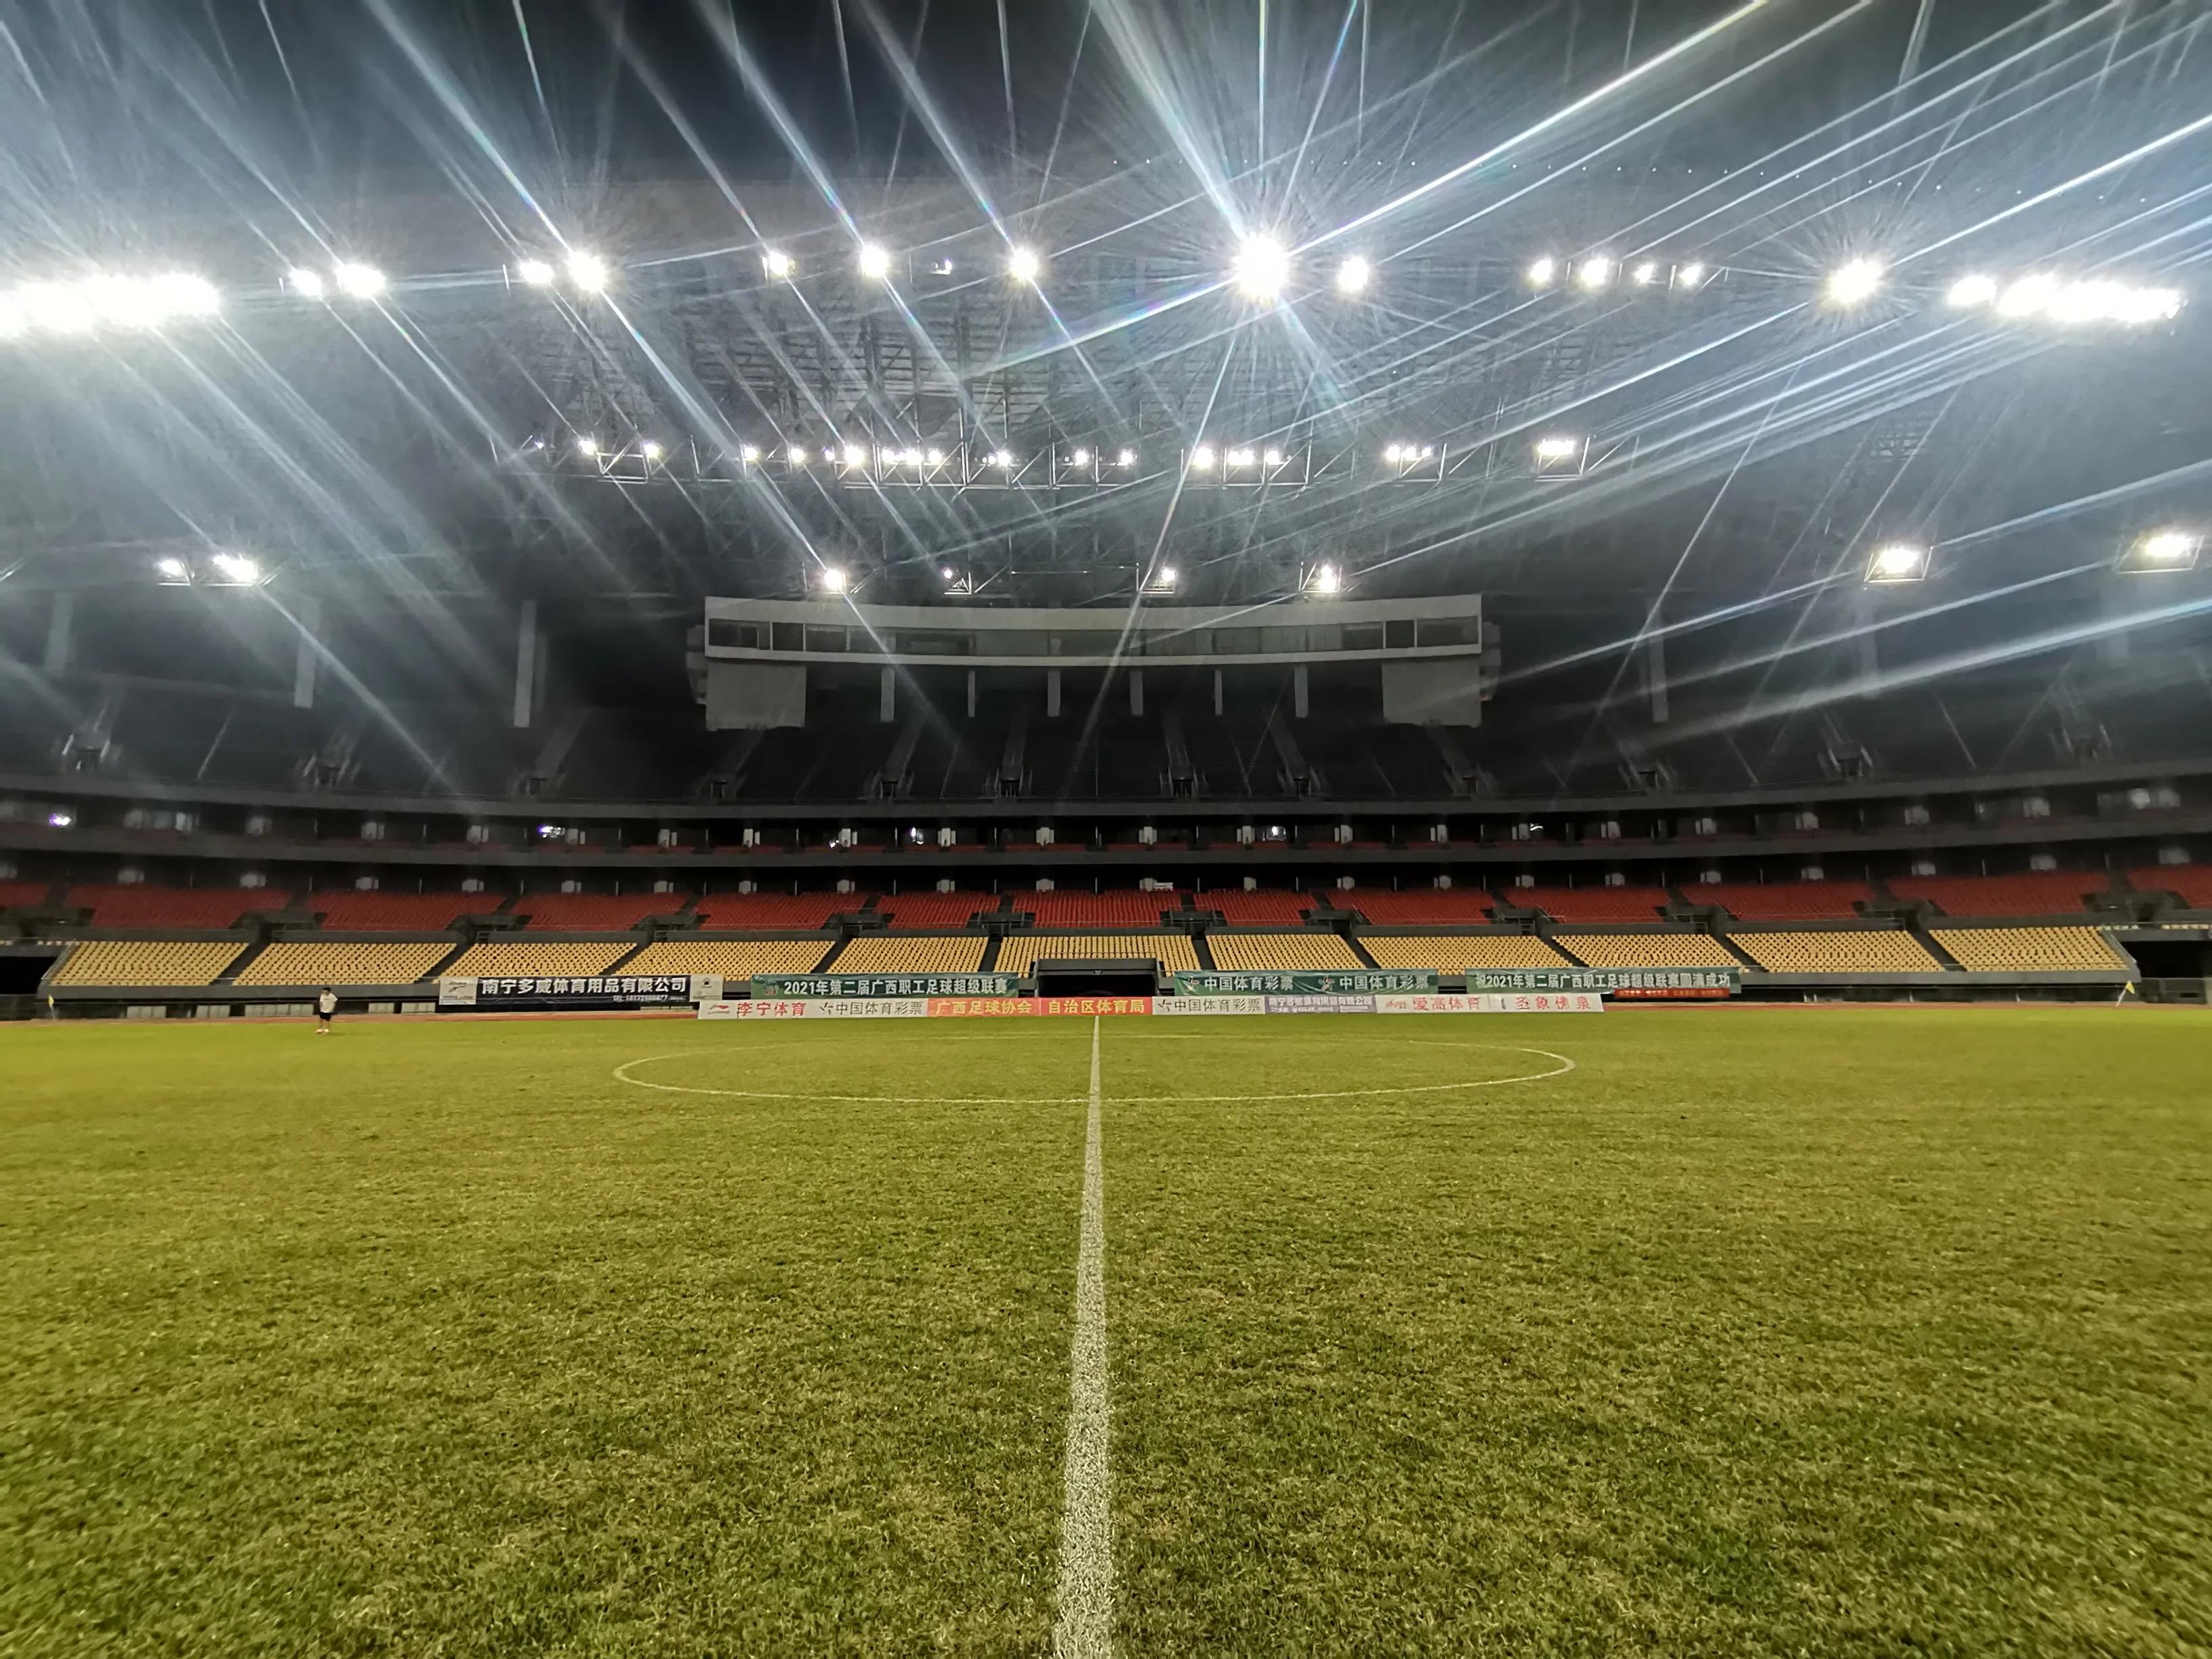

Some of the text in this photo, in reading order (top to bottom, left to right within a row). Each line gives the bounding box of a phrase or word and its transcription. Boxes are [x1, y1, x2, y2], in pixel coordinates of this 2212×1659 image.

[482, 977, 687, 994] 南宁多威体育用品有限公司
[784, 978, 1008, 996] 2021年第二届广西职工足球超级联赛
[1204, 976, 1294, 991] 中国体育彩票
[1340, 975, 1429, 991] 中国体育彩票
[737, 1002, 806, 1016] 李宁体育
[836, 1002, 923, 1015] 中国体育彩票
[935, 1000, 1032, 1015] 广西足球协会
[1048, 999, 1145, 1014] 自治区体育局
[1174, 998, 1261, 1012] 中国体育彩票
